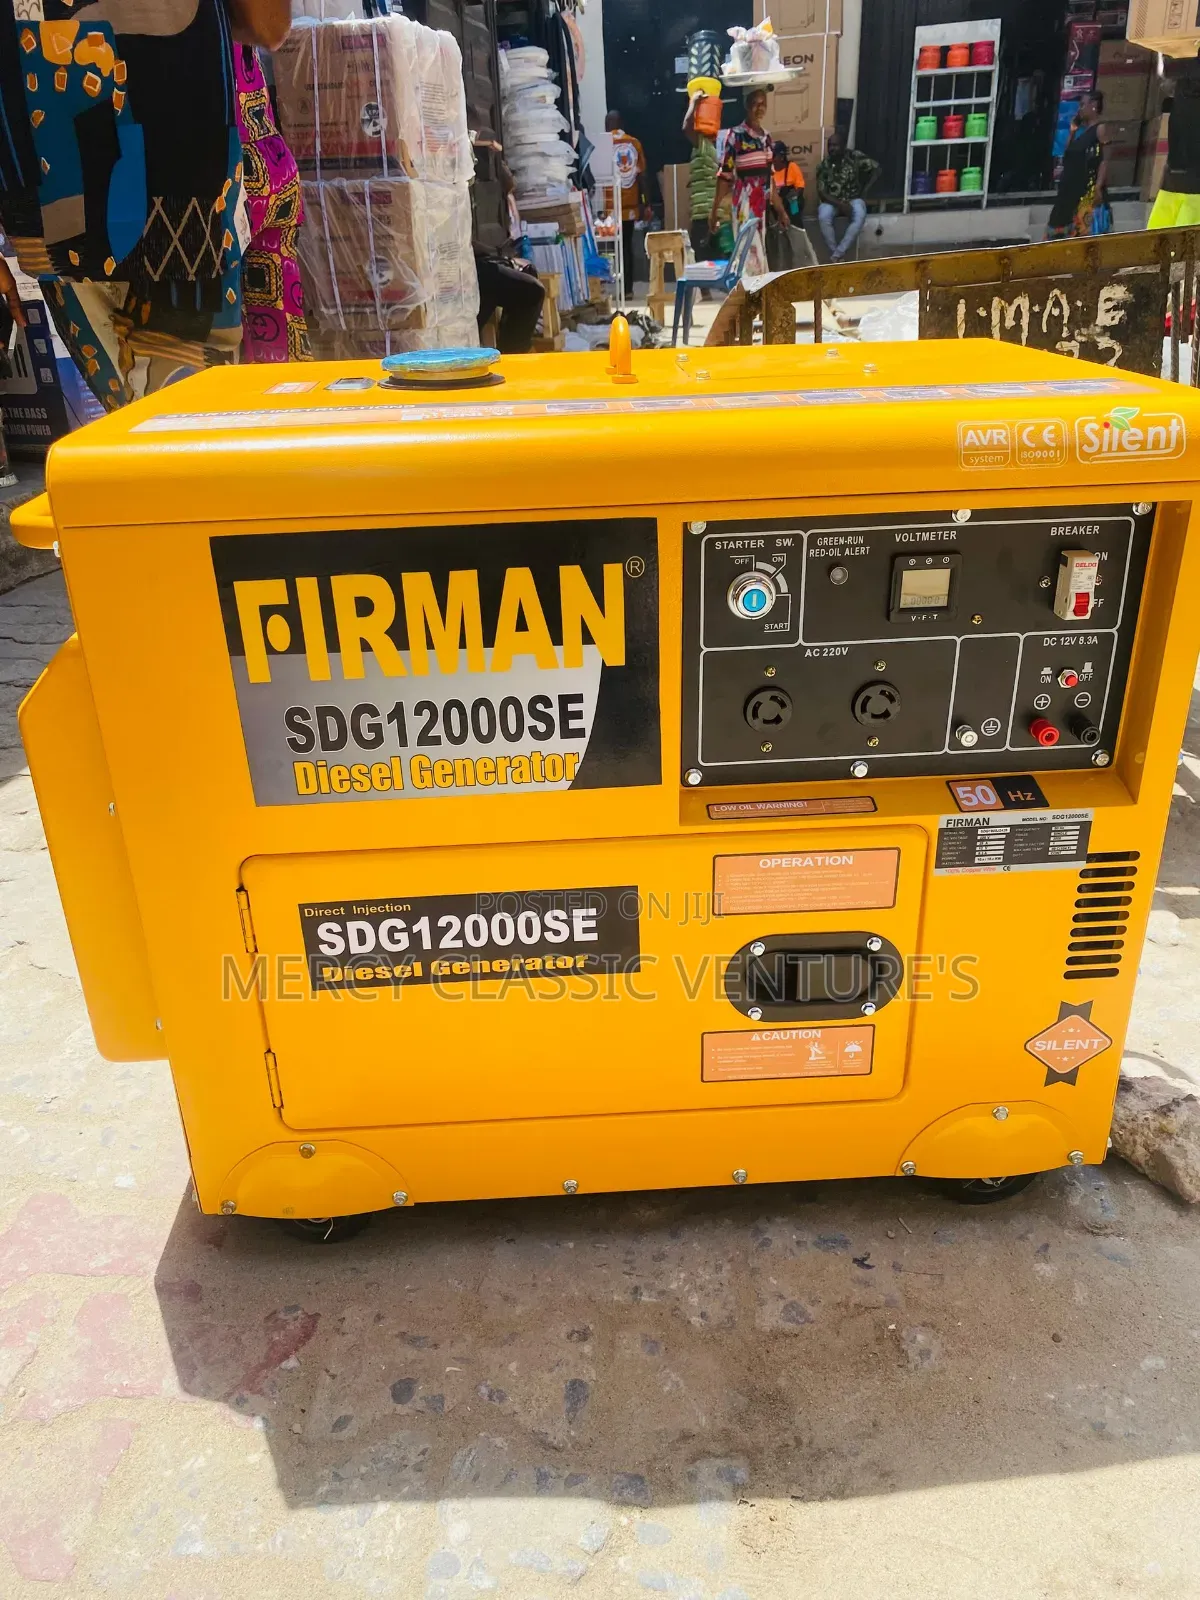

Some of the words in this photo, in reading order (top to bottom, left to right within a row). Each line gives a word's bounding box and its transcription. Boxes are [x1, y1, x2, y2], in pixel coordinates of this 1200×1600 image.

[780, 53, 814, 66] EON
[24, 407, 48, 419] BASS
[26, 424, 52, 436] POWER
[1082, 418, 1180, 453] Silent
[964, 429, 1007, 447] AVR
[969, 454, 1004, 466] system
[1020, 450, 1060, 459] ISO9001
[1050, 525, 1100, 536] BREAKER
[817, 536, 864, 546] GREEN-RUN
[895, 531, 957, 543] VOLTMETER
[715, 539, 765, 550] STARTER
[775, 538, 795, 547] SW.
[809, 548, 842, 558] RED-OIL
[844, 546, 870, 556] ALERT
[734, 557, 750, 565] OFF
[234, 563, 625, 684] FIRMAN
[764, 622, 788, 630] START
[1043, 637, 1057, 647] DC
[1060, 636, 1077, 646] 12V
[1078, 635, 1099, 645] 8.3A
[804, 648, 820, 658] AC
[822, 647, 849, 657] 220V
[1040, 675, 1052, 684] ON
[1078, 673, 1094, 682] OFF
[283, 692, 587, 755] SDG12000SE
[293, 755, 404, 796] Diesel
[409, 749, 580, 790] Generator
[956, 785, 997, 807] 50
[1007, 790, 1036, 802] Hz
[714, 804, 737, 812] LOW
[739, 803, 754, 811] OIL
[756, 801, 808, 810] WARNING!
[946, 817, 990, 828] FIRMAN
[759, 855, 854, 869] OPERATION
[304, 905, 346, 918] Direct
[352, 902, 412, 917] Injection
[317, 908, 599, 956] SDG12000SE
[321, 960, 424, 983] Diesel
[431, 952, 590, 978] Generator
[762, 1029, 822, 1041] CAUTION
[1034, 1038, 1103, 1051] SILENT
